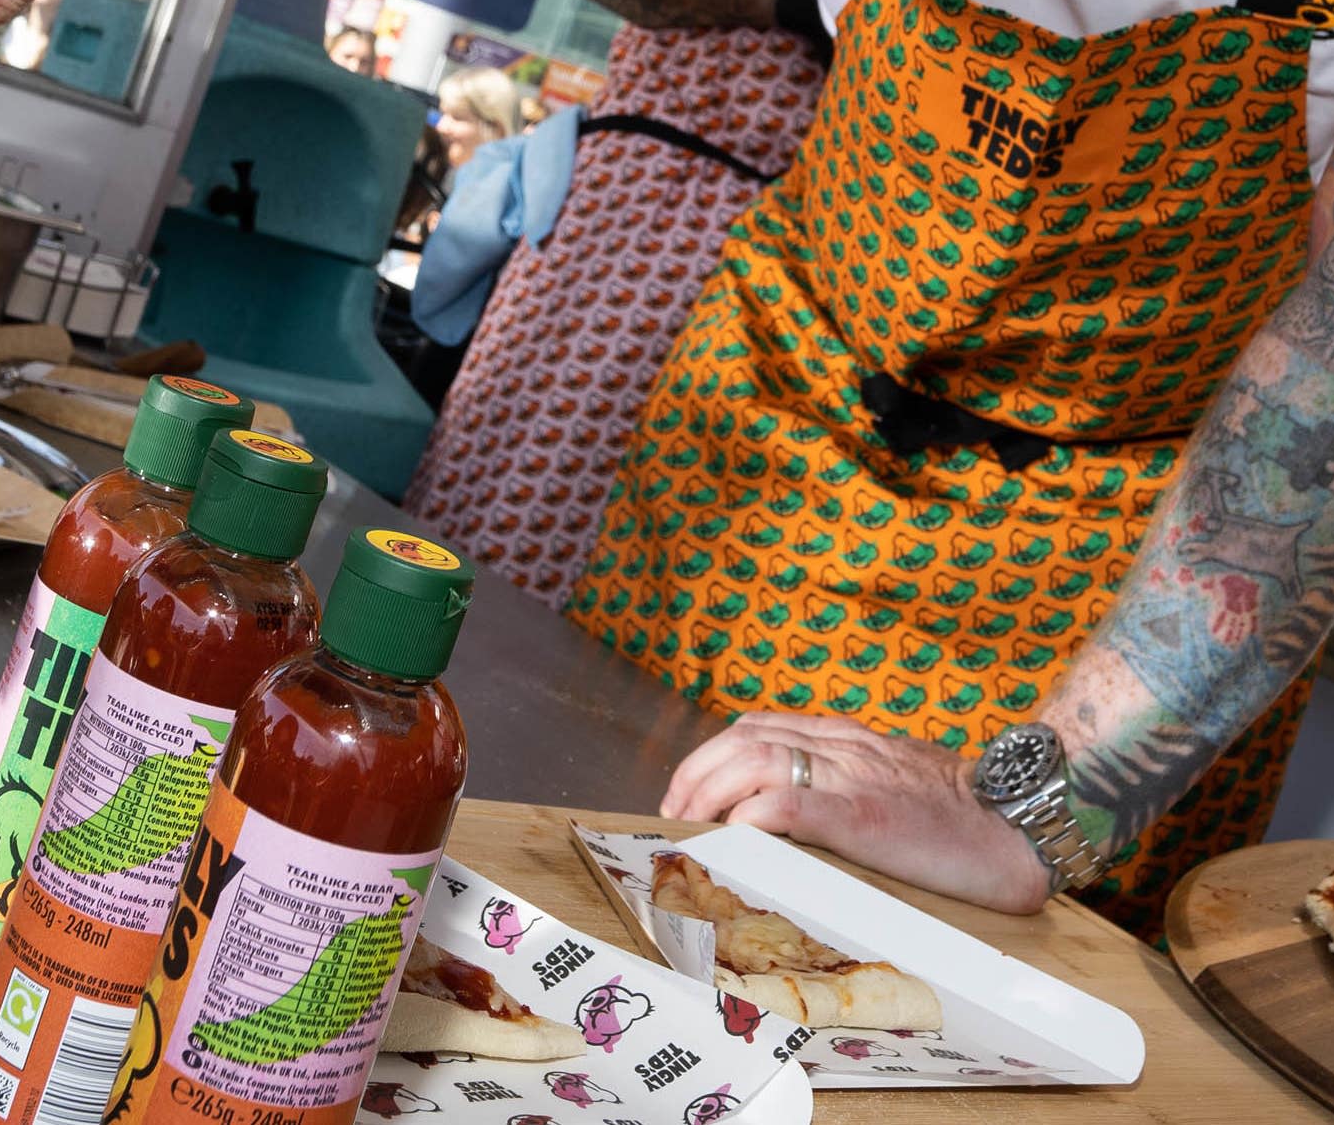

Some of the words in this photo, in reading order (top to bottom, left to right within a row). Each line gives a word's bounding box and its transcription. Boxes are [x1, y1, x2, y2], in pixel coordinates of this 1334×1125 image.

[962, 84, 1089, 155] TINGLY
[967, 120, 1064, 179] TED'S
[106, 707, 134, 729] (THEN
[135, 722, 184, 747] RECYCLE)
[107, 695, 128, 712] TEAR
[129, 705, 151, 723] LIKE
[152, 719, 160, 727] A
[163, 722, 193, 738] BEAR
[115, 732, 128, 746] PER
[129, 741, 147, 754] 100g
[168, 751, 181, 763] Hot
[182, 755, 202, 767] Chilli
[125, 790, 142, 804] 8.1g
[136, 779, 145, 793] 0g
[158, 783, 181, 797] Water,
[121, 800, 138, 817] 6.5g
[150, 803, 181, 820] Vinegar,
[154, 793, 177, 807] Grape
[178, 799, 196, 810] Juice
[113, 824, 130, 839] 2.4g
[118, 813, 134, 826] 0.9g
[143, 823, 171, 837] Tomato
[173, 830, 191, 842] Paste
[147, 814, 195, 832] Concentrated
[104, 832, 131, 851] Smoked
[131, 843, 147, 857] Sea
[147, 847, 163, 861] Salt,
[106, 845, 125, 862] Herb,
[147, 860, 176, 873] Extract.
[139, 836, 165, 848] Lemon
[166, 842, 184, 855] Pulp,
[86, 852, 100, 866] Use.
[100, 859, 119, 872] After
[120, 867, 151, 886] Opening
[287, 864, 318, 882] TEAR
[321, 875, 349, 889] LIKE
[352, 882, 361, 892] A
[365, 883, 394, 894] BEAR
[66, 882, 95, 906] Company
[96, 896, 131, 916] (Ireland)
[132, 907, 150, 922] Ltd.,
[89, 878, 100, 891] UK
[101, 884, 117, 899] Ltd.,
[119, 890, 150, 907] London,
[238, 891, 265, 913] Energy
[258, 886, 302, 913] NUTRITION
[303, 903, 321, 918] PER
[324, 909, 345, 922] 100g
[289, 877, 328, 898] (THEN
[330, 891, 384, 907] RECYCLE)
[107, 913, 119, 925] Co.
[119, 918, 146, 931] Dublin
[234, 905, 247, 918] Fat
[63, 914, 112, 949] 248ml
[229, 919, 239, 929] of
[239, 921, 262, 938] which
[263, 933, 305, 955] saturates
[332, 951, 343, 962] 0g
[225, 931, 280, 963] Carbohydrate
[531, 937, 580, 976] TED'S
[43, 955, 85, 980] TRADEMARK
[87, 975, 97, 984] OF
[98, 978, 109, 988] ED
[111, 980, 145, 995] SHEERAN
[212, 969, 227, 985] Salt
[216, 956, 245, 979] Protein
[311, 989, 330, 1003] 0.9g
[220, 944, 230, 956] of
[230, 947, 253, 967] which
[254, 959, 284, 979] sugars
[315, 976, 334, 991] 6.5g
[539, 944, 596, 992] TINGLY
[55, 973, 73, 988] USED
[75, 981, 100, 997] UNDER
[102, 990, 134, 1004] LICENSE.
[203, 995, 228, 1016] Starch,
[229, 1008, 260, 1026] Smoked
[261, 1021, 297, 1039] Paprika,
[298, 1027, 320, 1039] Herb,
[207, 984, 235, 1006] Ginger,
[235, 998, 258, 1013] Spirit
[295, 1014, 327, 1027] Smoked
[213, 1028, 239, 1047] Before
[222, 1020, 241, 1034] Well
[241, 1027, 270, 1044] Before
[272, 1038, 290, 1051] Use.
[291, 1043, 313, 1054] After
[314, 1042, 345, 1056] Opening
[773, 1026, 817, 1064] ED'S
[225, 1051, 251, 1068] Heinz
[252, 1061, 278, 1075] Foods
[279, 1065, 292, 1076] UK
[634, 1042, 685, 1078] TED'S
[642, 1050, 702, 1093] TINGLY
[202, 1059, 218, 1074] H.J.
[220, 1068, 245, 1084] Heinz
[246, 1078, 286, 1095] Company
[225, 1082, 251, 1100] Court,
[252, 1090, 297, 1108] Blackrock,
[298, 1095, 310, 1105] Co.
